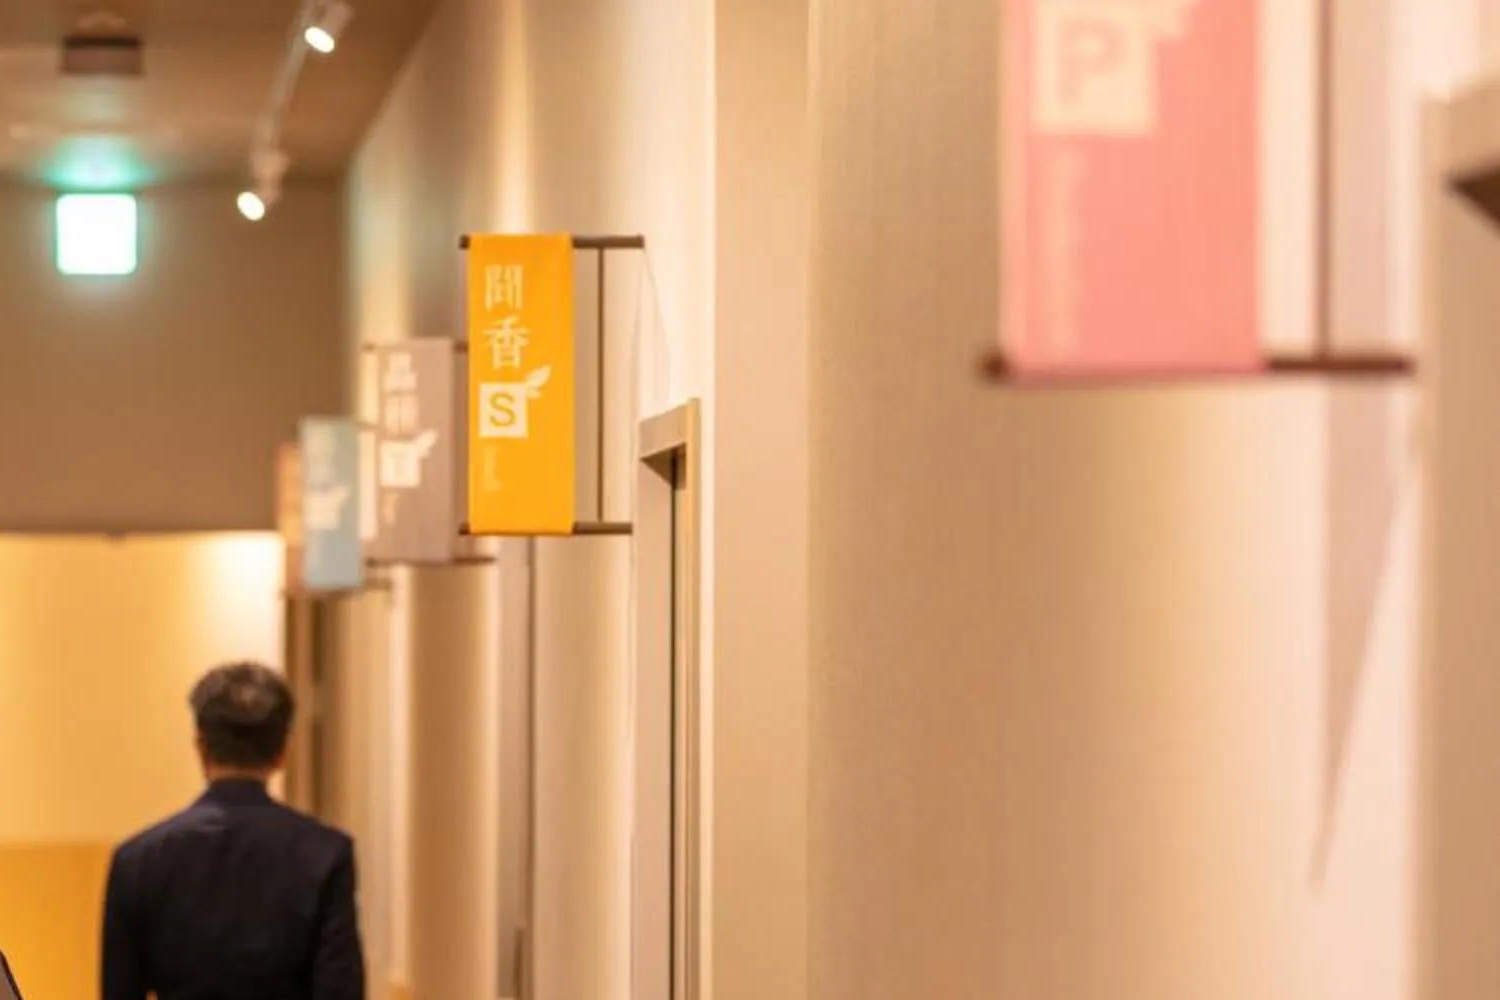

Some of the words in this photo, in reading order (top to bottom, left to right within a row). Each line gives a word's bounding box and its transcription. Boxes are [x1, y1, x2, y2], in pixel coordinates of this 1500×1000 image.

[1056, 15, 1129, 107] P
[483, 264, 530, 369] 聞香
[488, 390, 517, 429] S
